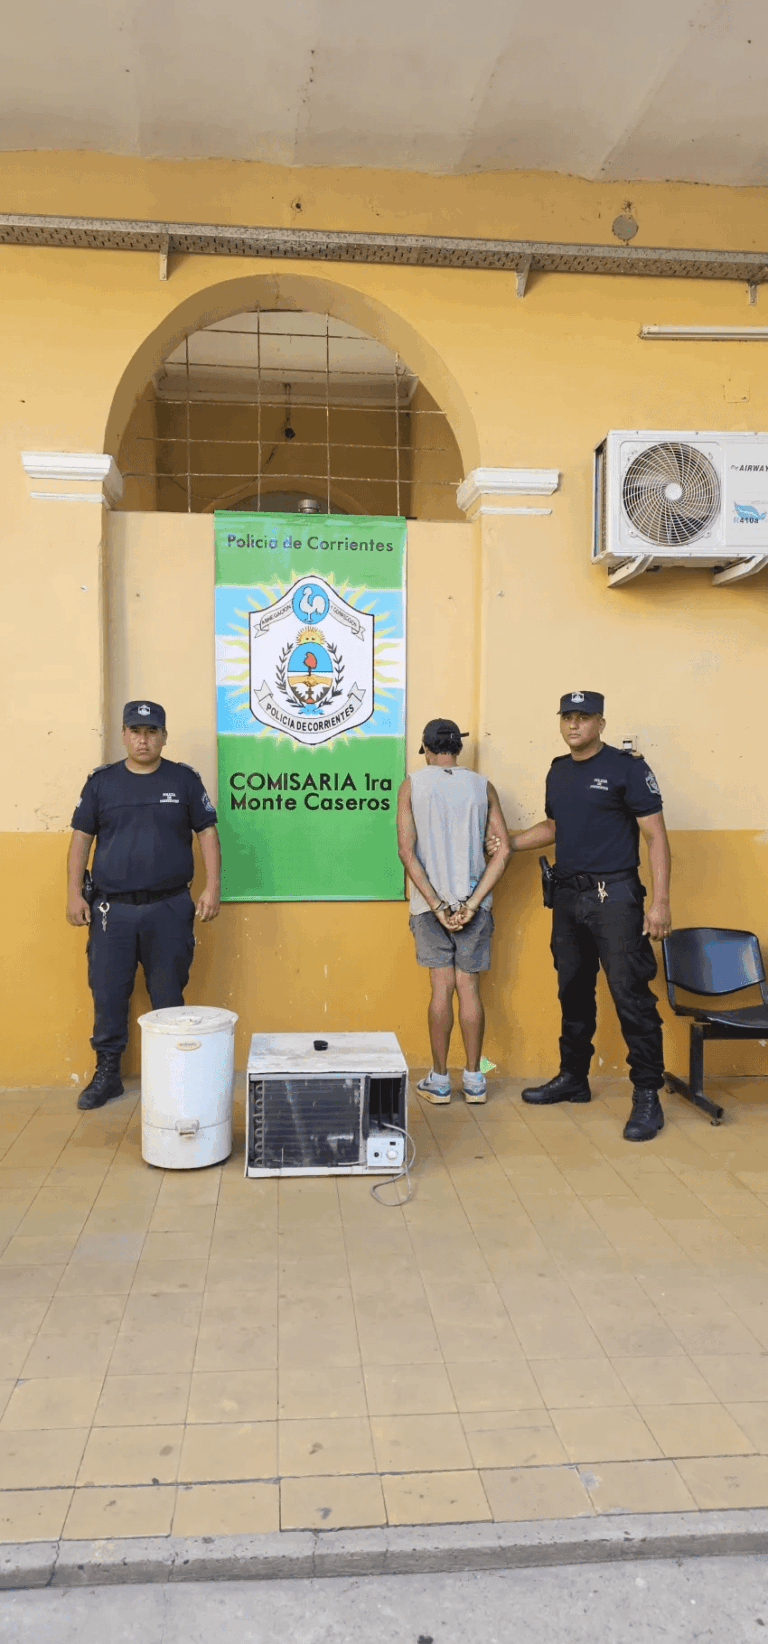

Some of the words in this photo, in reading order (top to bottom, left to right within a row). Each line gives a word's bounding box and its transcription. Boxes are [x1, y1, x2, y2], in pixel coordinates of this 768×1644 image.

[227, 534, 278, 549] Policia
[283, 535, 302, 549] de
[307, 536, 393, 551] Corrientes
[266, 702, 295, 730] POLICIA
[296, 720, 307, 731] DE
[307, 704, 354, 732] CORRIENTES
[229, 772, 357, 791] COMISARIA
[364, 773, 392, 791] 1ra
[230, 792, 297, 811] Monte
[304, 792, 390, 811] Caseros
